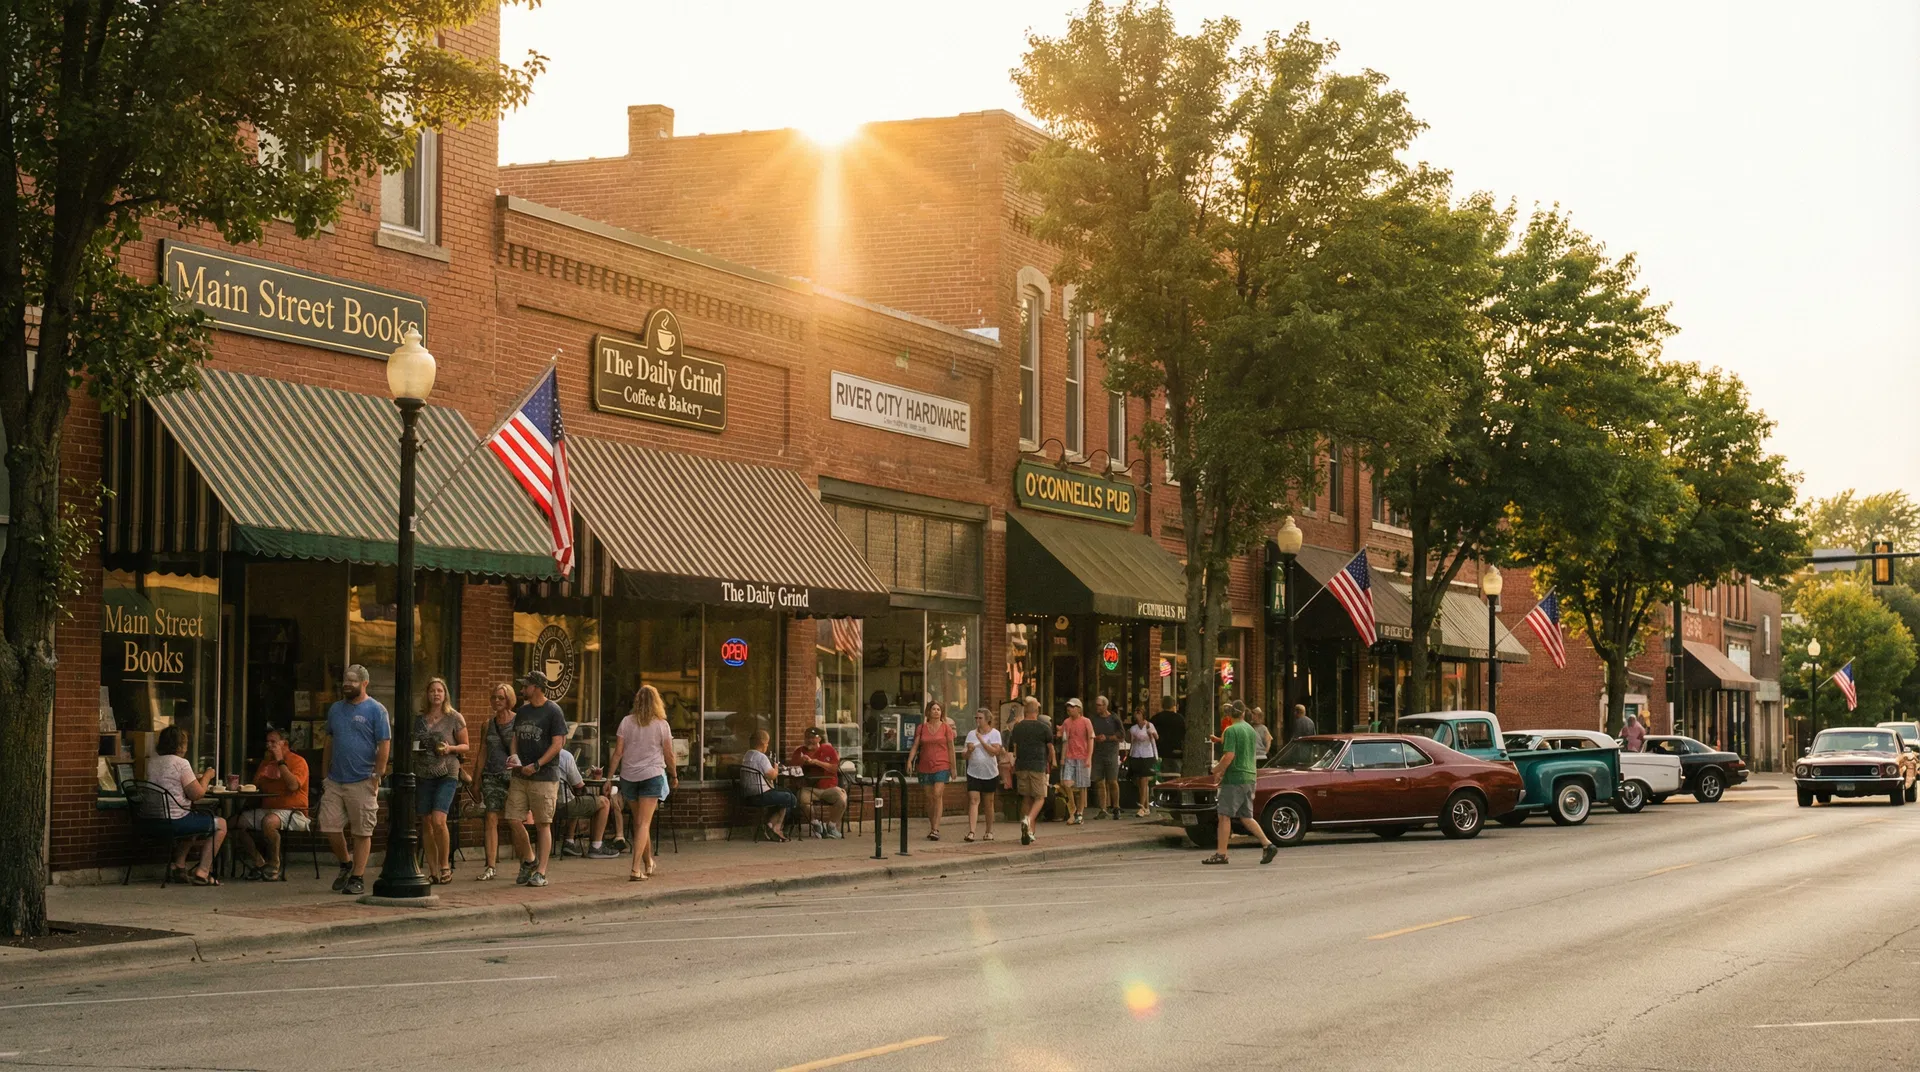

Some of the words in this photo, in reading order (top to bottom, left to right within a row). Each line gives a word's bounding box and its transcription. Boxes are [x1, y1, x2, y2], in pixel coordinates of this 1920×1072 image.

[176, 261, 249, 314] Main
[259, 279, 335, 330] Street
[602, 347, 633, 378] The
[636, 355, 677, 393] Daily
[680, 365, 722, 396] Grind
[624, 386, 656, 407] Coffee
[658, 392, 667, 410] &
[669, 394, 703, 420] Bakery
[836, 382, 872, 412] RIVER
[875, 391, 903, 418] CITY
[906, 399, 967, 432] HARDWARE
[1106, 488, 1131, 514] PUB
[721, 581, 745, 603] The
[746, 584, 776, 610] Daily
[778, 586, 809, 608] Grind
[104, 604, 150, 635] Main
[154, 607, 204, 638] Street
[123, 640, 184, 674] Books
[721, 643, 748, 660] OPEN
